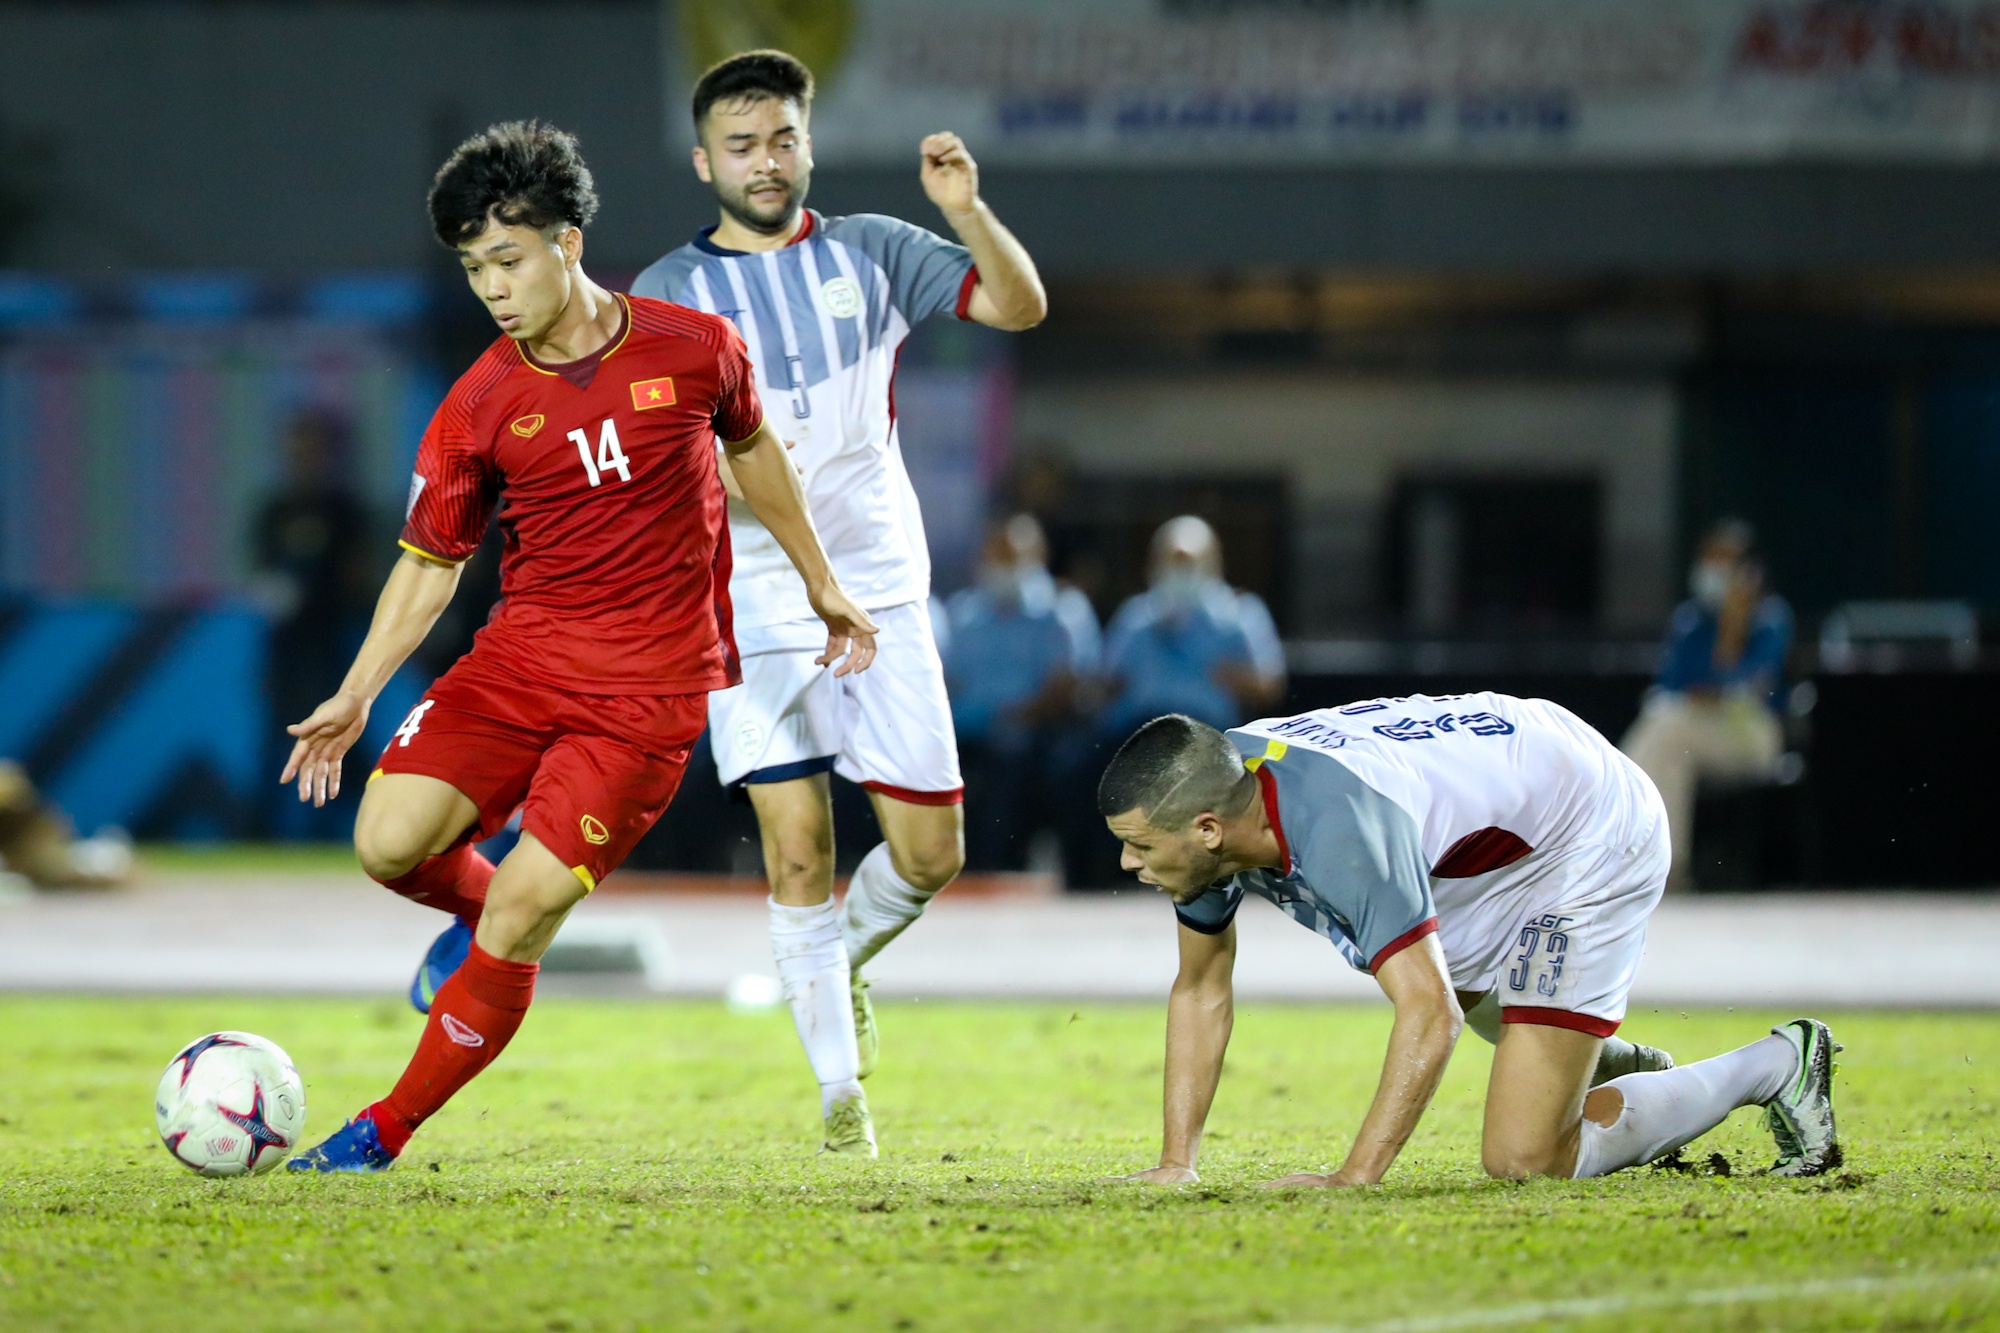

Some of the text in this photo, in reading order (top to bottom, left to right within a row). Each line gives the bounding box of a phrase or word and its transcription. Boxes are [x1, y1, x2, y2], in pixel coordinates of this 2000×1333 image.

[784, 355, 811, 419] 5
[566, 418, 632, 487] 14
[1509, 927, 1568, 997] 33
